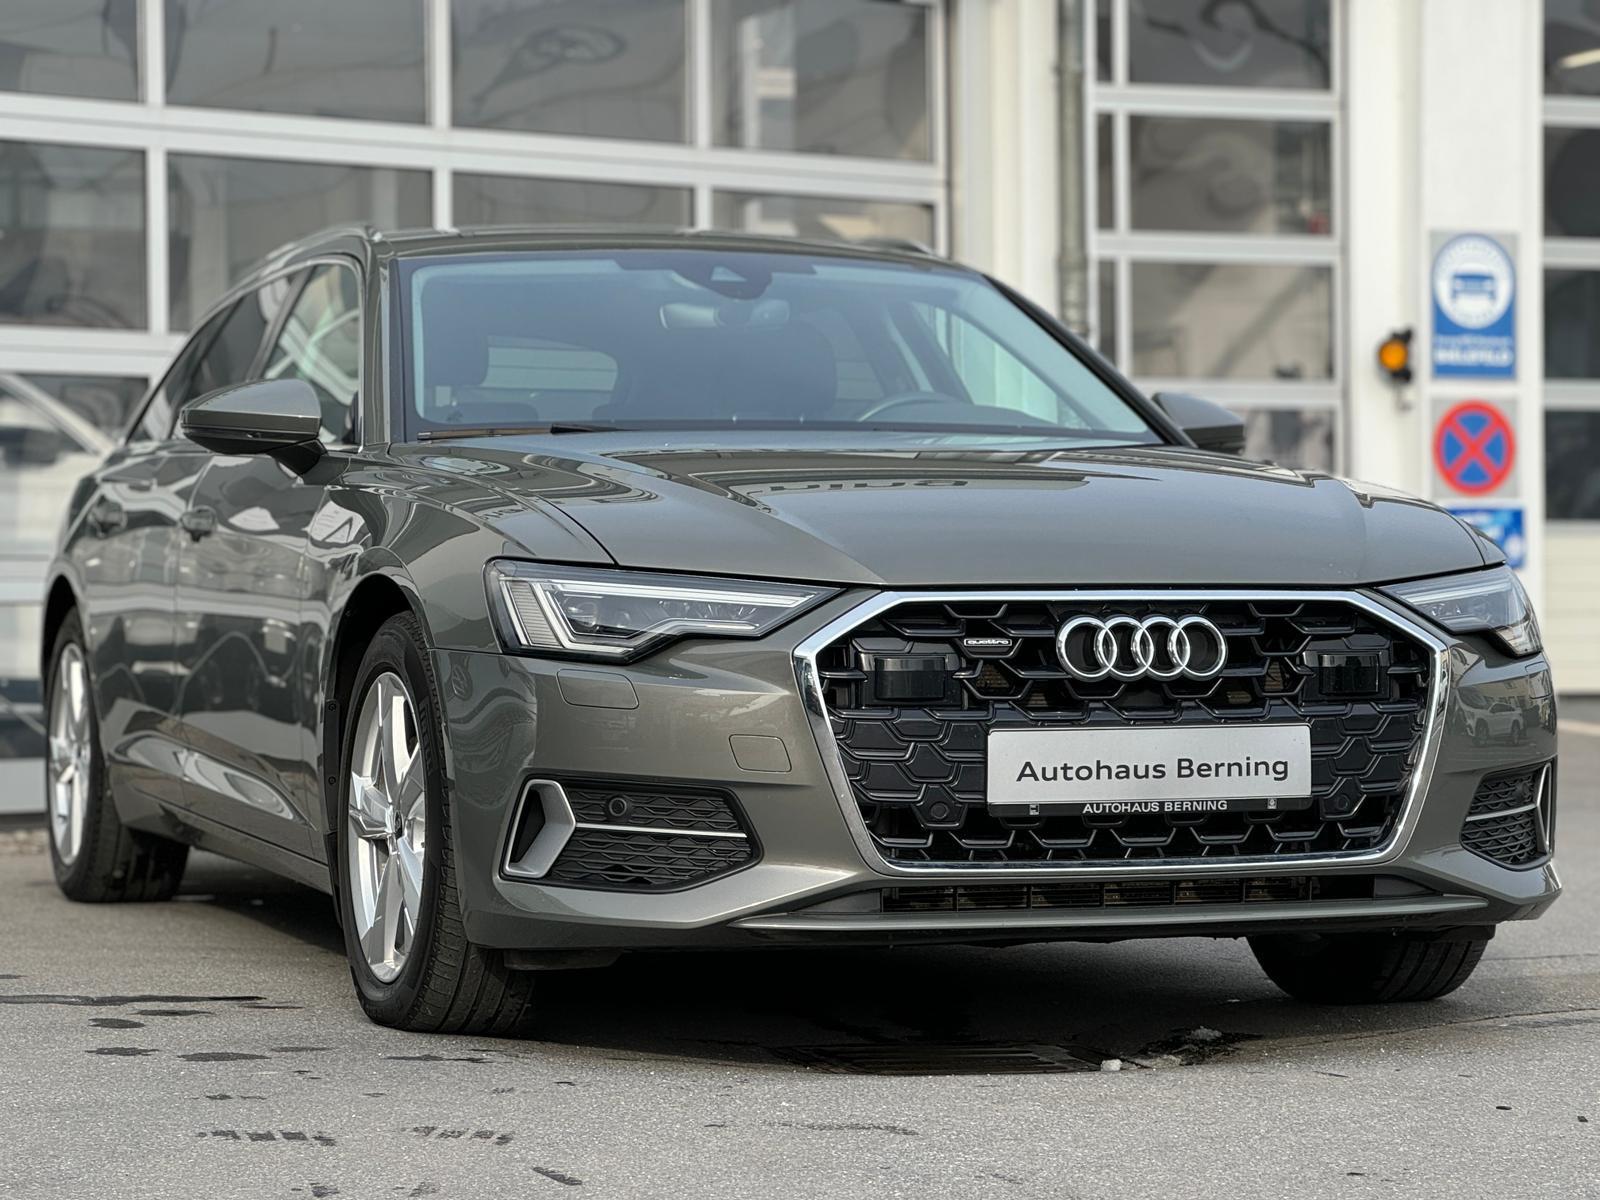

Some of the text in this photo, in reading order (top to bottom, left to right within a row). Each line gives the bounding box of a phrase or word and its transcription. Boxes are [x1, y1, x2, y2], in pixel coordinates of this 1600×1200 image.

[1016, 757, 1289, 782] Autohaus Berning
[1082, 800, 1228, 814] AUTOHAUS BERNING
